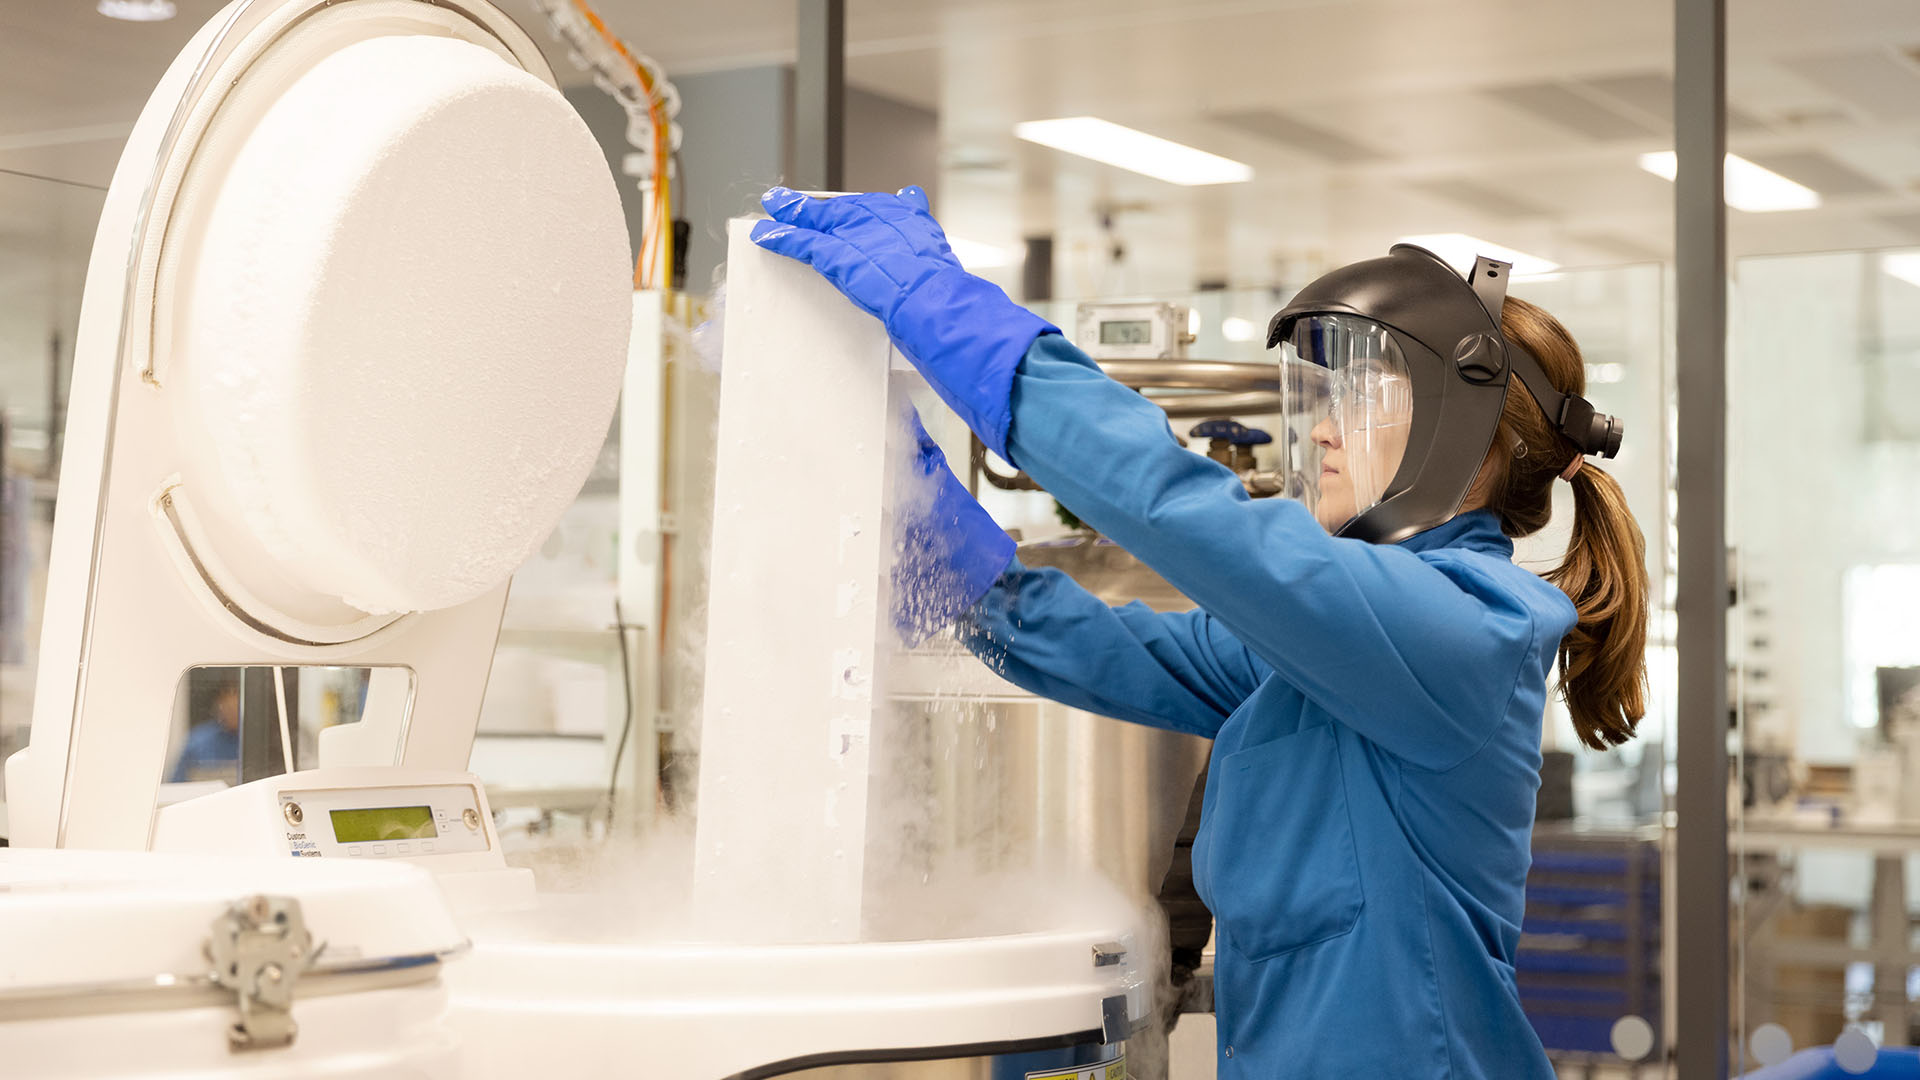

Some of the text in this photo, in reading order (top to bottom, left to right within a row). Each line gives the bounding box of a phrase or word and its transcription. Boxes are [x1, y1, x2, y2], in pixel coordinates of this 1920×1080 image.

[286, 832, 307, 841] Custom
[293, 840, 317, 849] BioGenic
[300, 849, 322, 857] Systems
